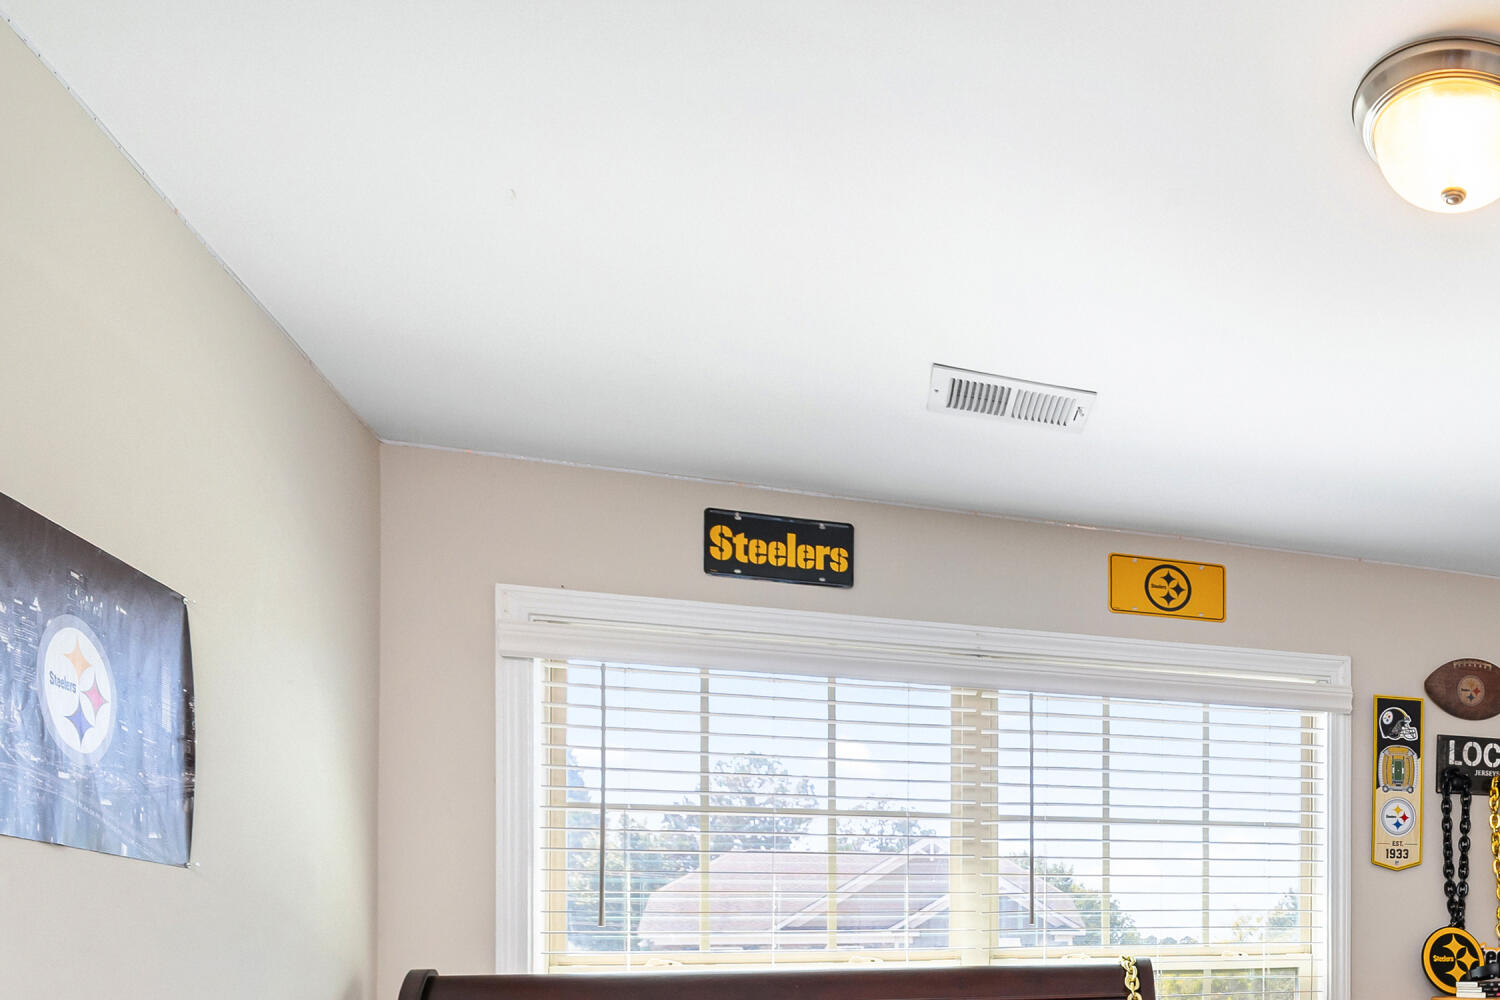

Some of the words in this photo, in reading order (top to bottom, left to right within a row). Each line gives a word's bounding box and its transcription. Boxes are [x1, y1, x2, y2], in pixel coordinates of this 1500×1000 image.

[709, 524, 849, 573] Steelers
[49, 670, 77, 693] Steelers
[1385, 848, 1409, 859] 1933
